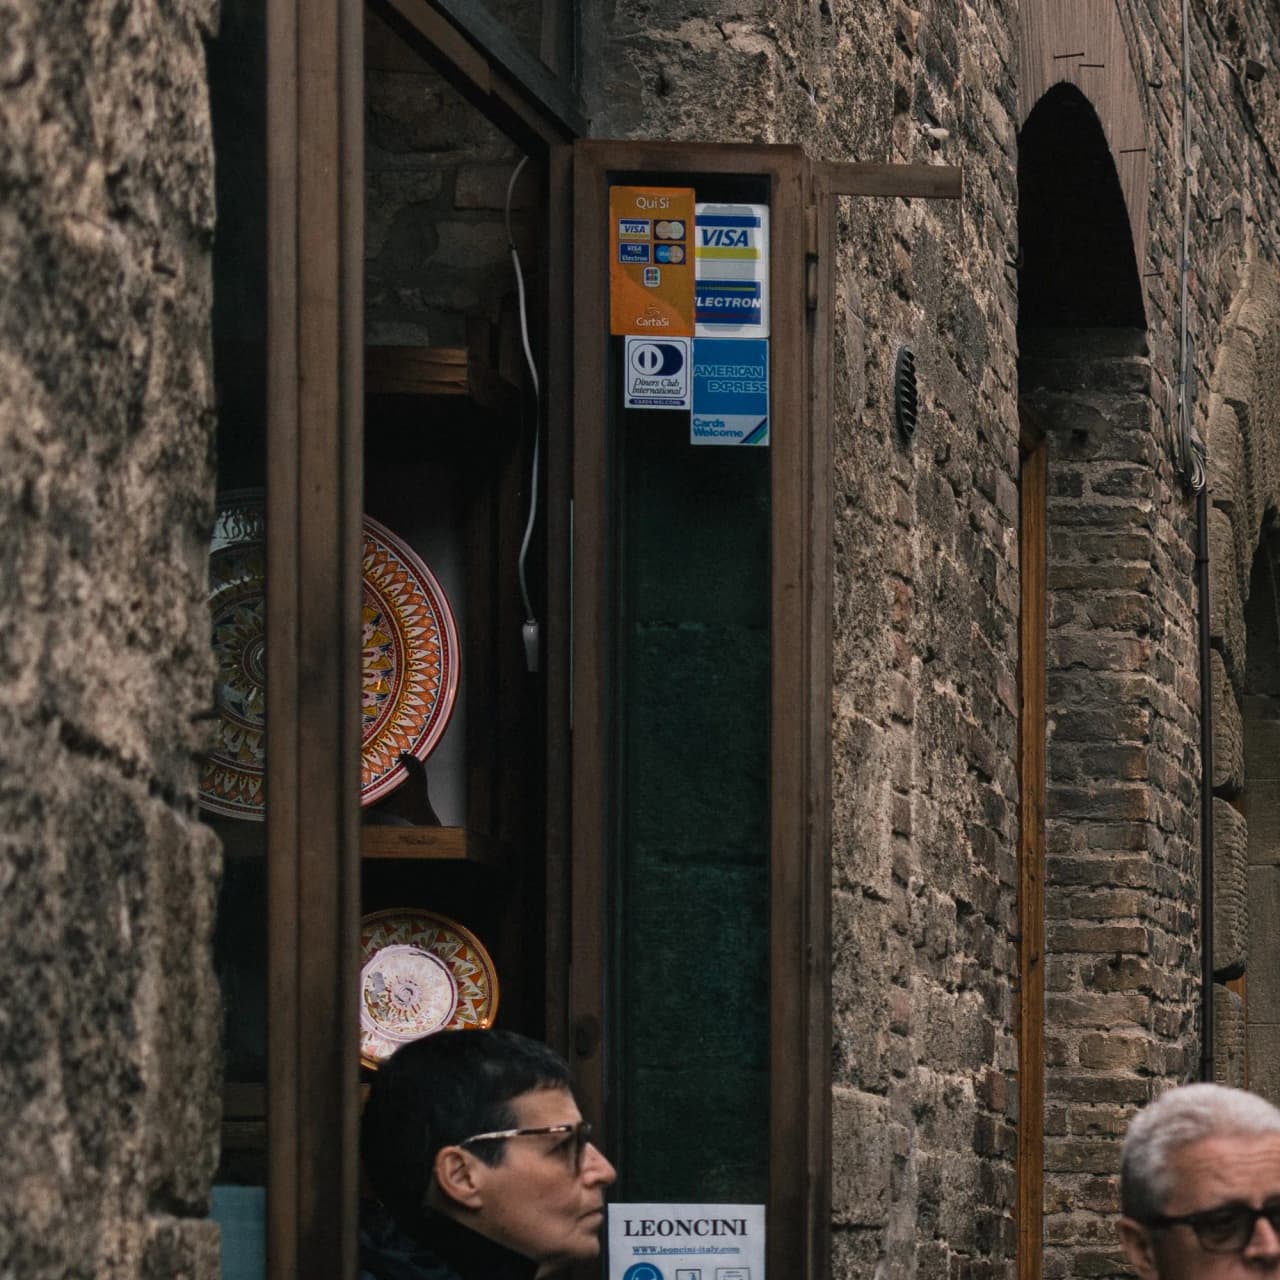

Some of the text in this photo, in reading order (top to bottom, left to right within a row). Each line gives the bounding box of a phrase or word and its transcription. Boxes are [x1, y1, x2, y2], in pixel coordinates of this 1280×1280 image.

[624, 225, 646, 233] VISA
[702, 229, 749, 247] VISA
[695, 297, 761, 308] LECTRON
[636, 317, 670, 327] CartaSi
[695, 365, 763, 377] AMERICAN
[708, 381, 768, 392] EXPRESS
[693, 418, 725, 428] Cards
[693, 427, 744, 438] Welcome
[623, 1219, 748, 1237] LEONCINI
